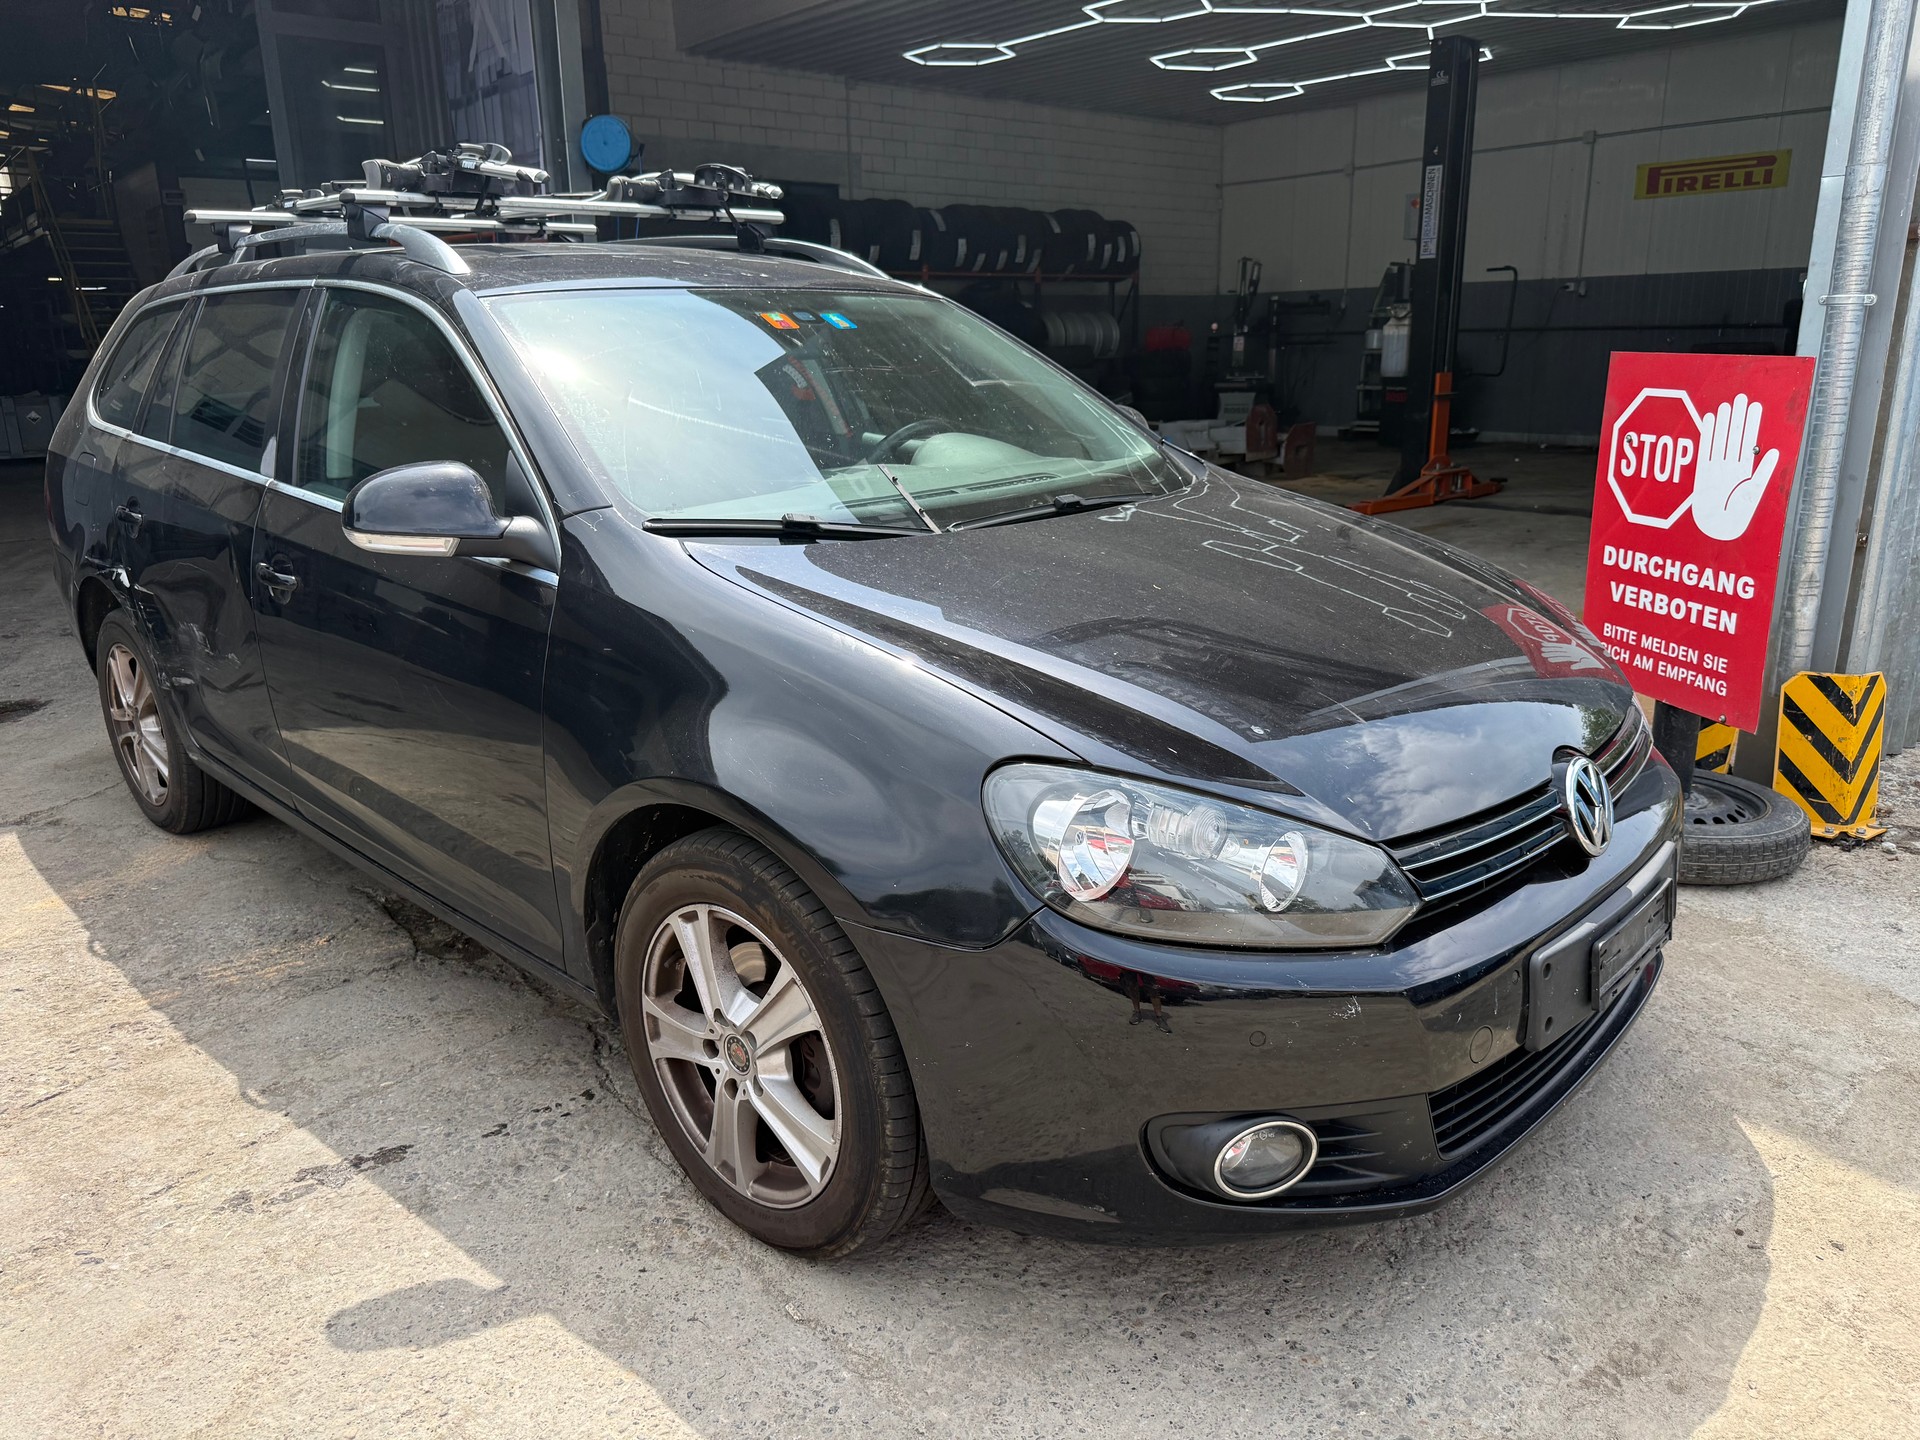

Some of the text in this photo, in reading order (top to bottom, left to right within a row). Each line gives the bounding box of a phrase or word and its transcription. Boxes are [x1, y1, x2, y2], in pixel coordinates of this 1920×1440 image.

[1645, 155, 1777, 195] PIRELLI
[1620, 431, 1694, 484] STOP
[1602, 545, 1756, 600] DURCHGANG
[1609, 580, 1738, 635] VERBOTEN
[1603, 622, 1728, 674] BITTE MELDEN SIE
[1632, 654, 1654, 672] AM
[1657, 660, 1727, 697] EMPFANG
